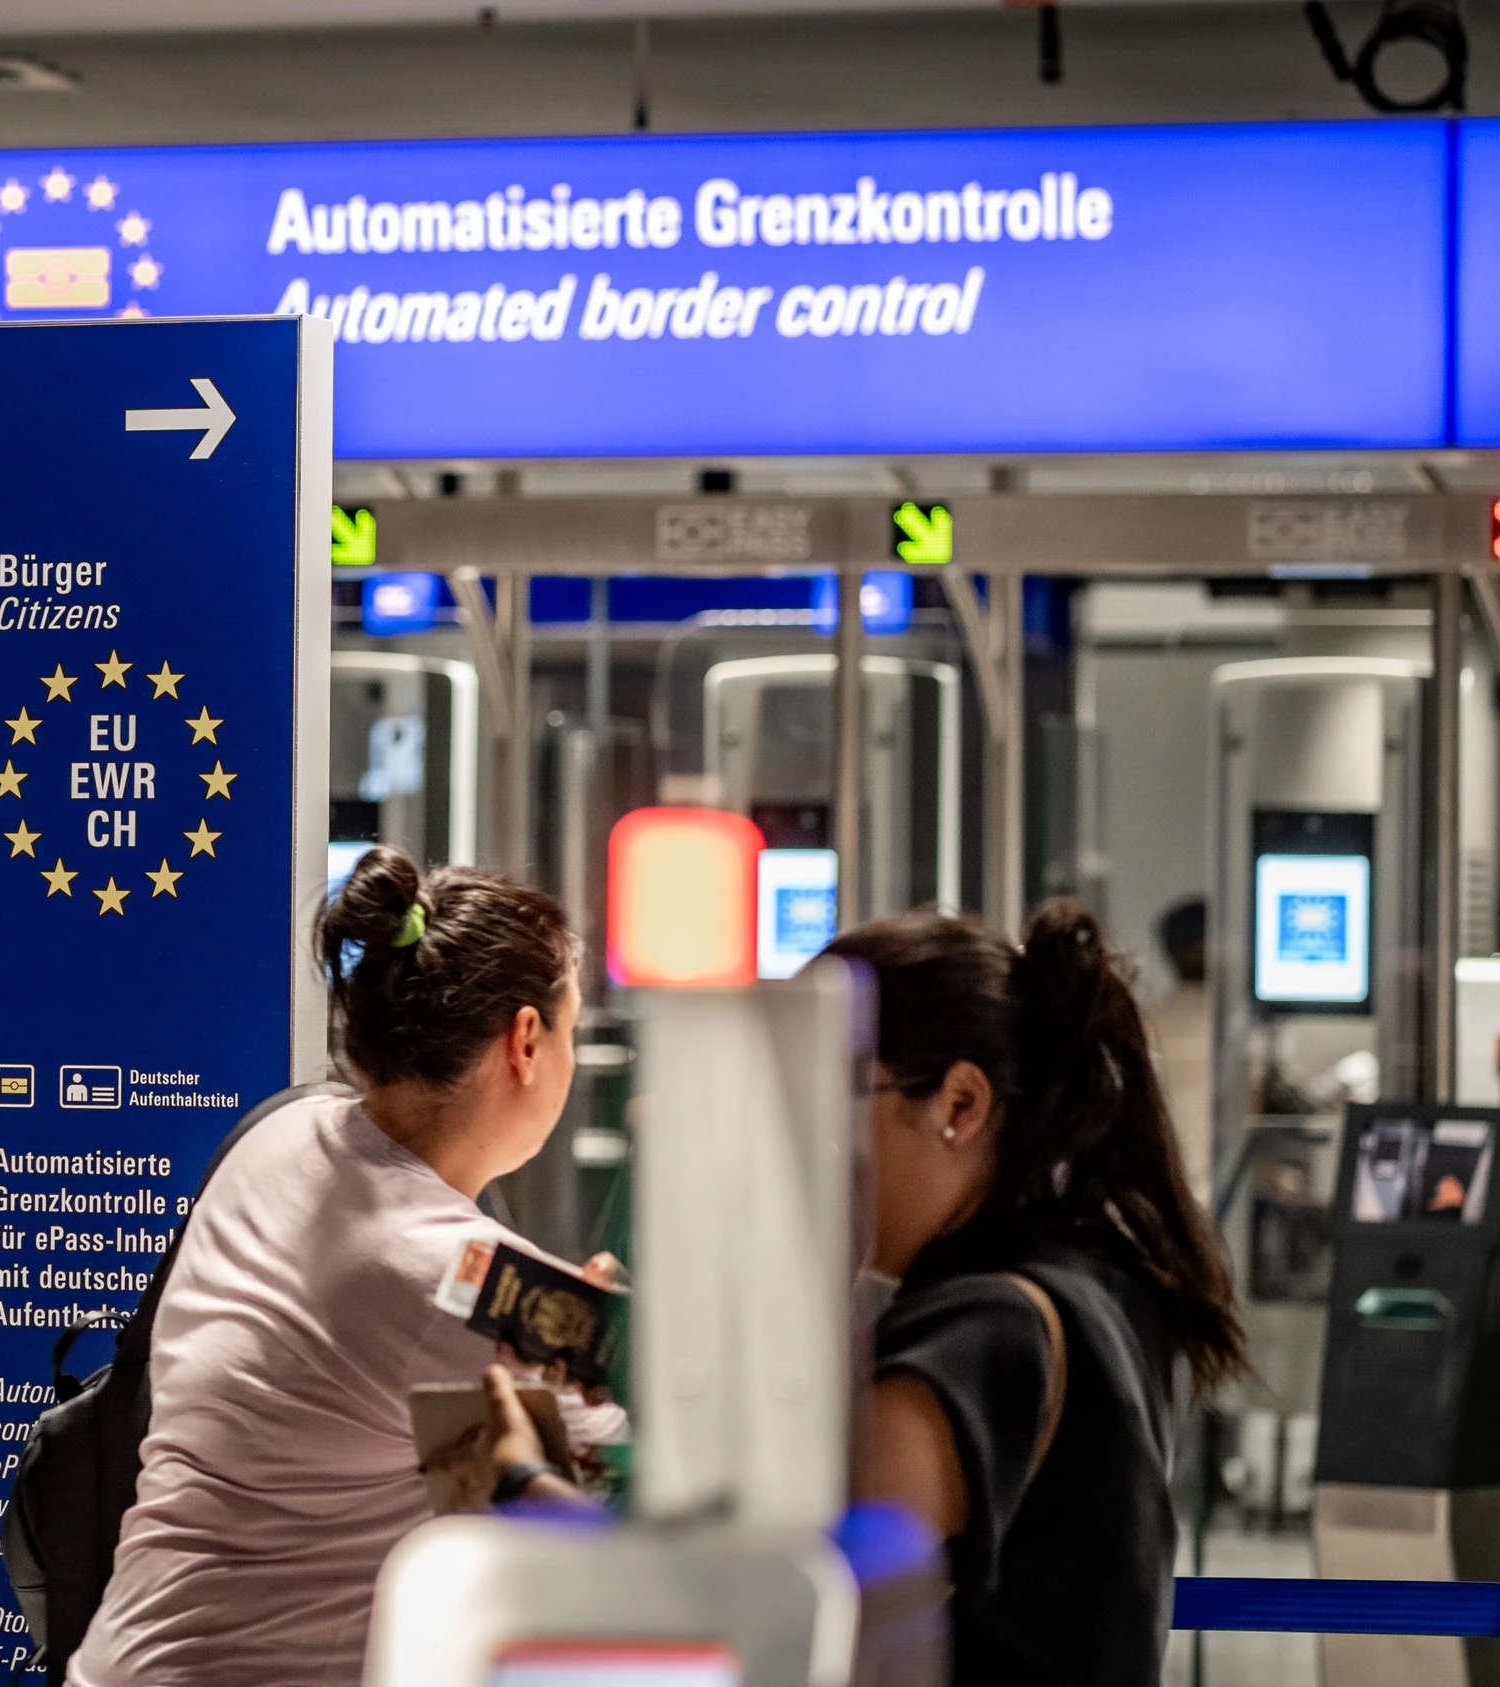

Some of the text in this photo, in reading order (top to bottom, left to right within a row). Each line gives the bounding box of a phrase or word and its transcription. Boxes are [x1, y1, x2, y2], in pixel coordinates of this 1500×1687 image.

[268, 172, 1113, 254] Automatisierte Grenzkontrolle
[274, 267, 985, 343] Automated border control
[0, 554, 107, 595] Bürger
[90, 714, 136, 752] EU
[70, 762, 155, 799] EWR
[87, 809, 136, 848] CH
[130, 1069, 200, 1086] Deutscher
[129, 1090, 239, 1108] Aufenthaltstitel
[176, 1196, 195, 1215] a
[39, 1263, 154, 1291] deutsche
